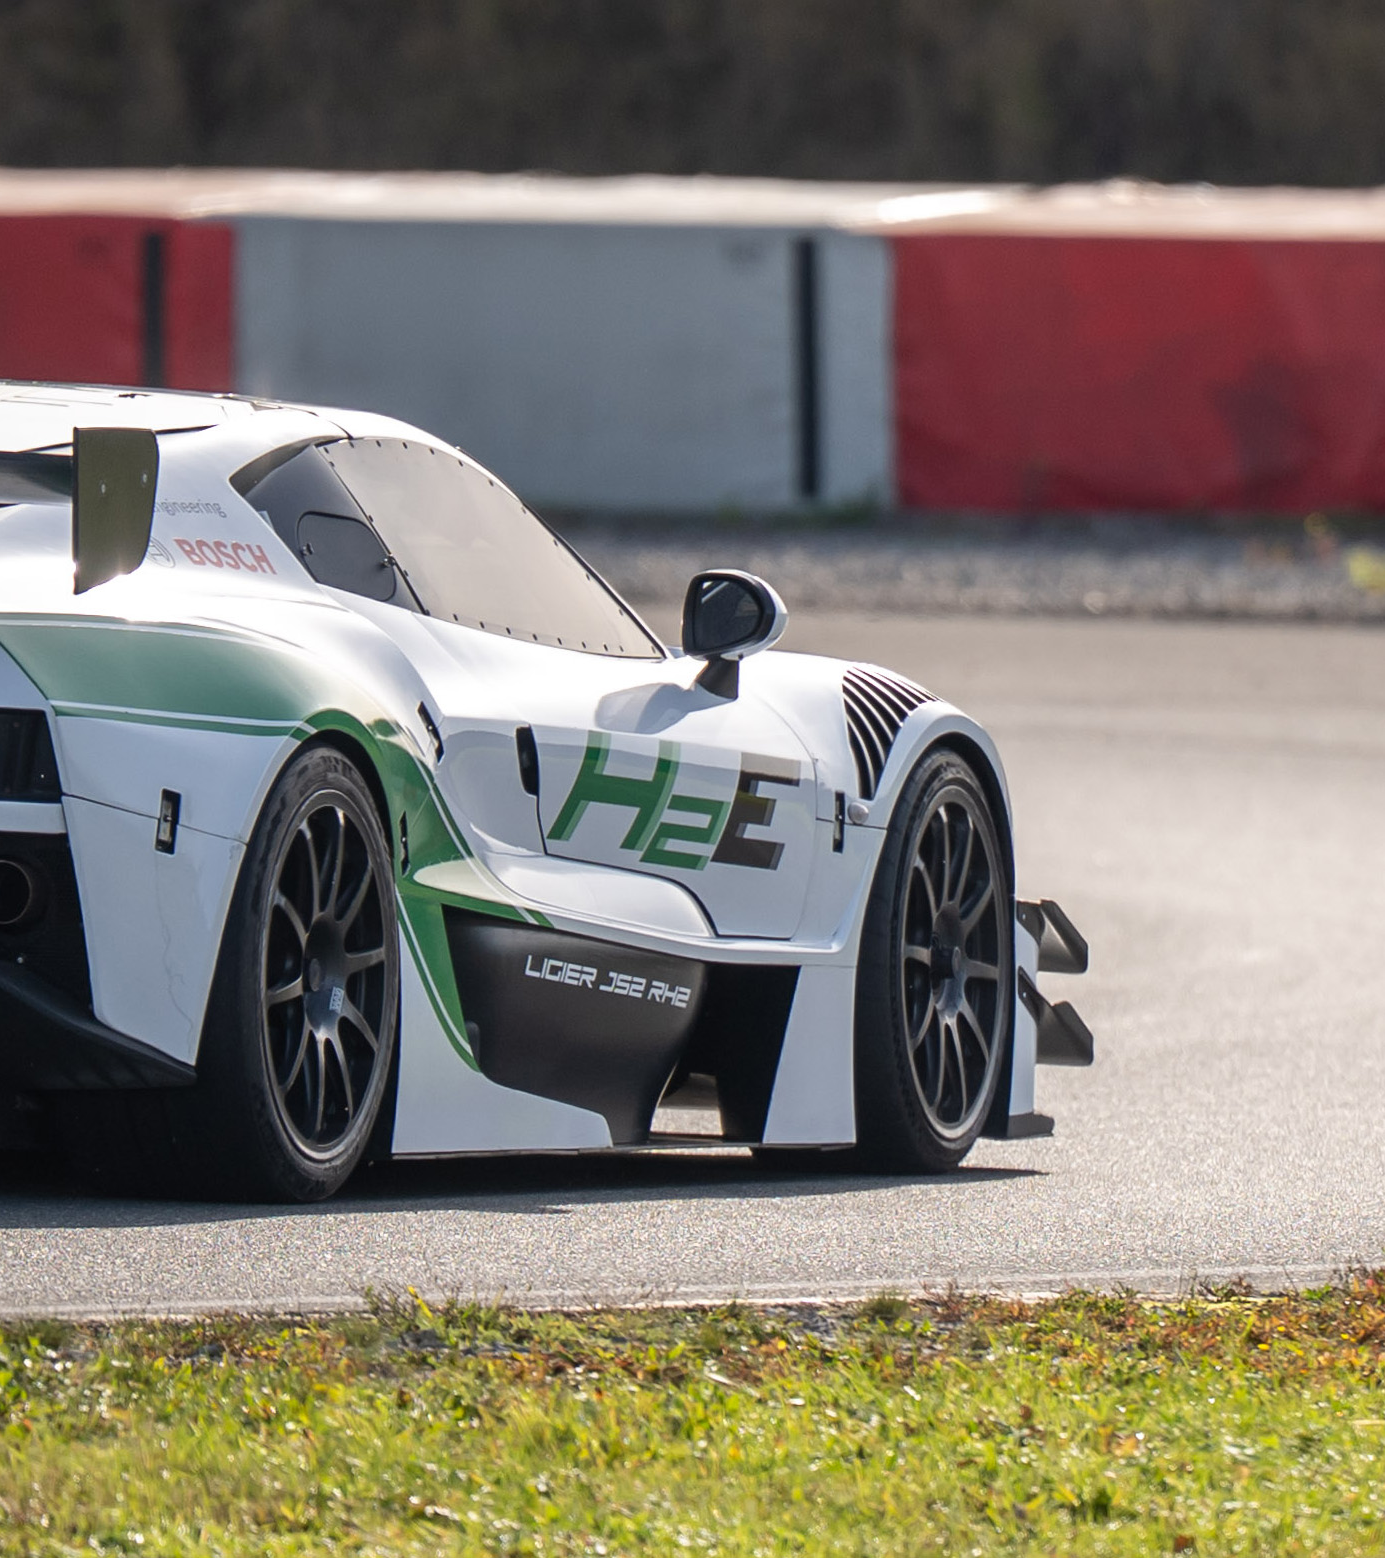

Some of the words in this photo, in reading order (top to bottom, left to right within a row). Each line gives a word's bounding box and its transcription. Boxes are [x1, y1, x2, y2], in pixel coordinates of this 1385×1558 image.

[154, 498, 227, 518] ngineering
[172, 538, 278, 575] BOSCH
[546, 729, 802, 871] H2E
[524, 954, 598, 989] LIGIER
[599, 971, 647, 998] JS2
[647, 980, 692, 1009] RH2
